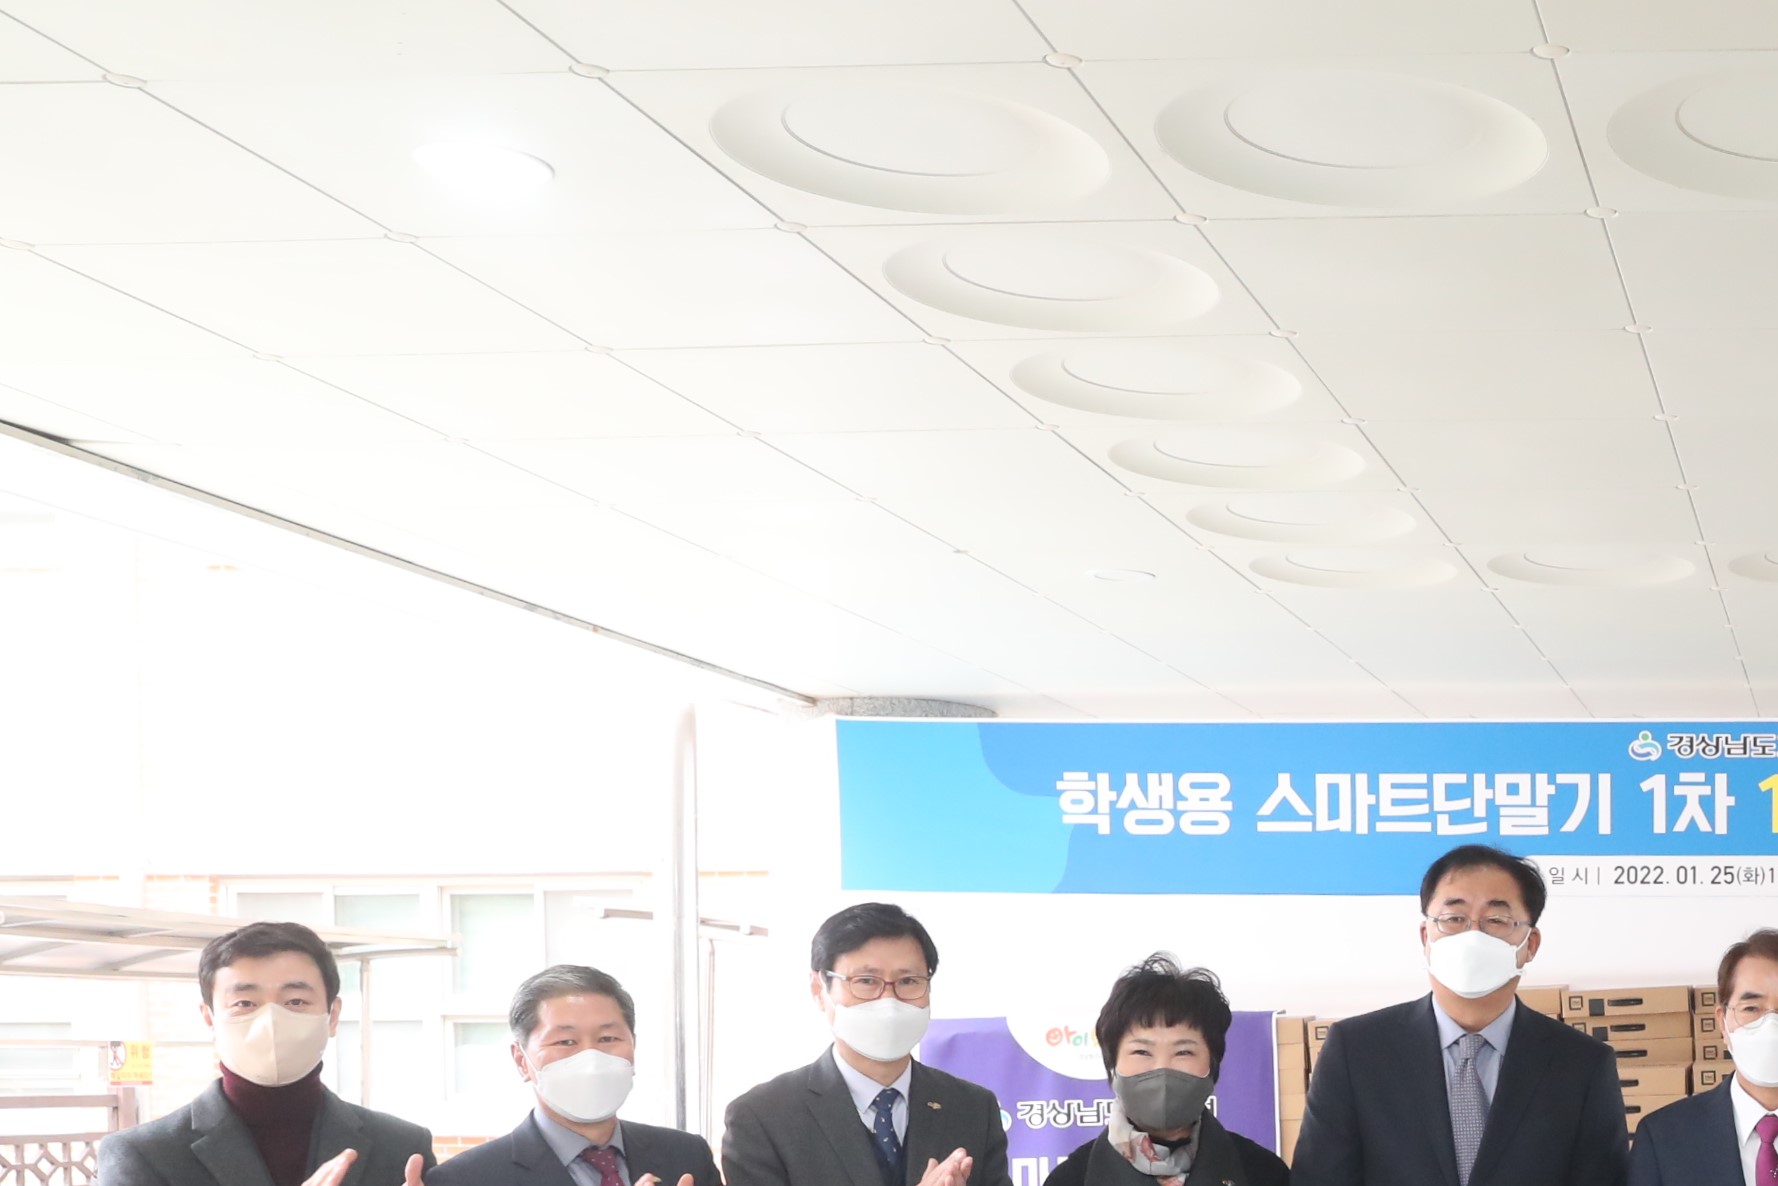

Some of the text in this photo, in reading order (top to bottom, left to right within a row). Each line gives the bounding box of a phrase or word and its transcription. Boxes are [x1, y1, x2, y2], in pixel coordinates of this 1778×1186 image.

[1056, 771, 1232, 835] 학생용
[1257, 772, 1611, 835] 스마트단말기
[1640, 772, 1735, 835] 1차
